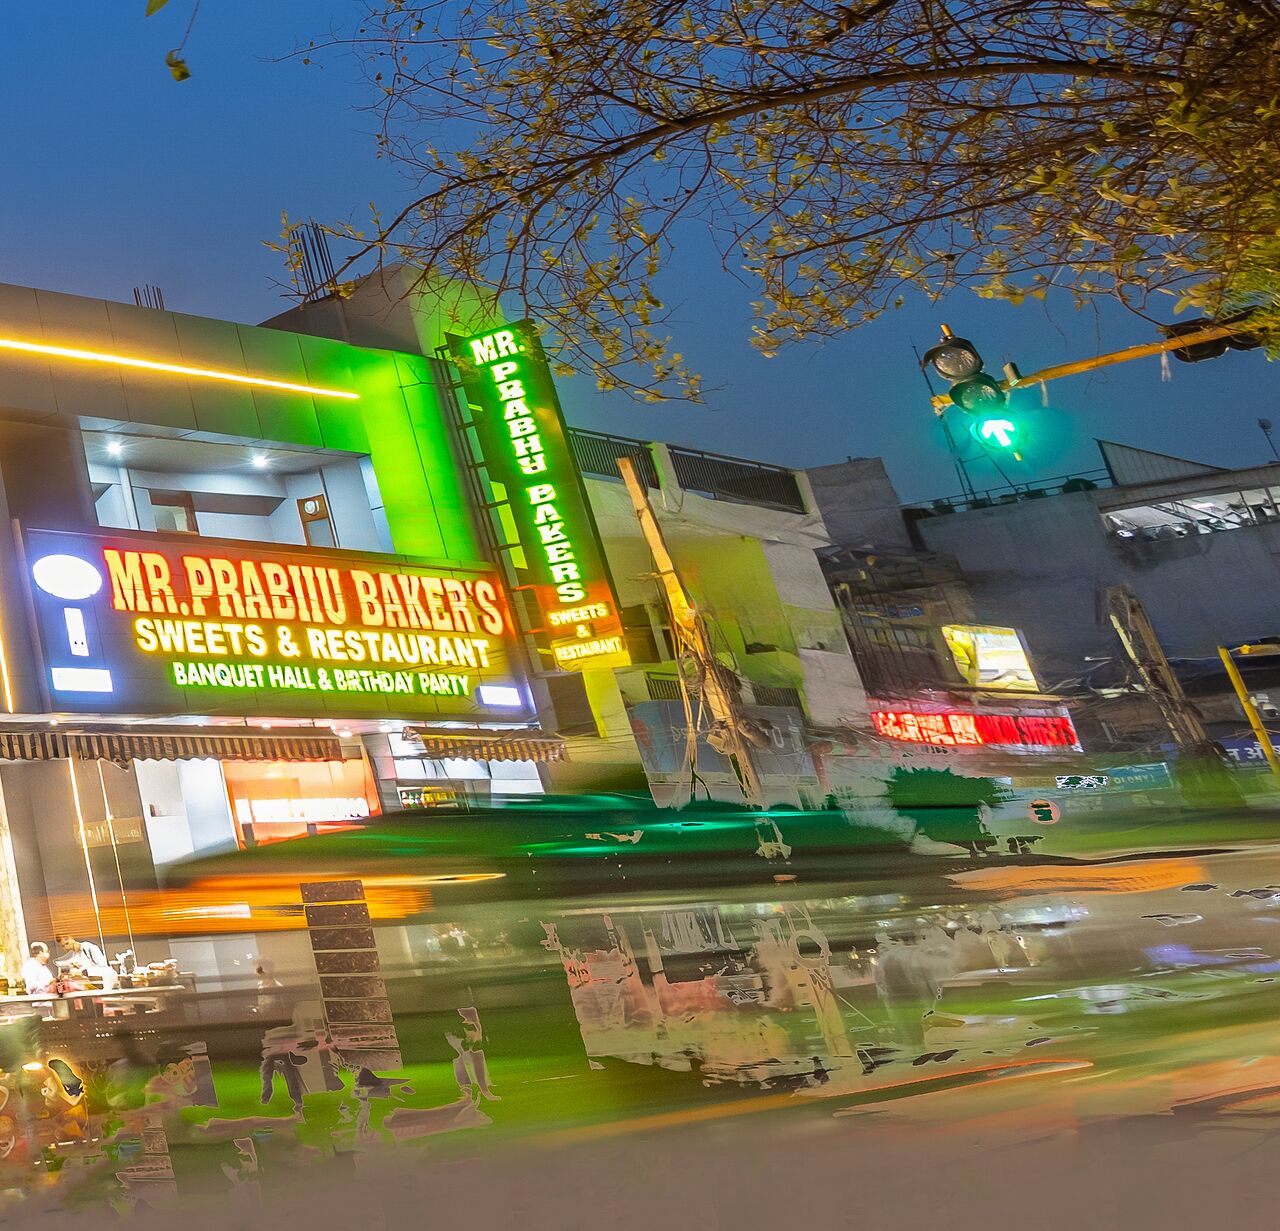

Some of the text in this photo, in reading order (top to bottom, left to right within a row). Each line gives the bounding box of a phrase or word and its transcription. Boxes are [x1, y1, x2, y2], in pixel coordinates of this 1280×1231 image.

[470, 330, 526, 366] MR.
[349, 569, 504, 636] BAKER'S
[548, 602, 607, 626] SWEETS
[136, 618, 490, 668] SWEETS & RESTAURANT
[576, 624, 590, 638] &
[173, 662, 470, 697] BANQUET HALL & BIRTHDAY PARTY
